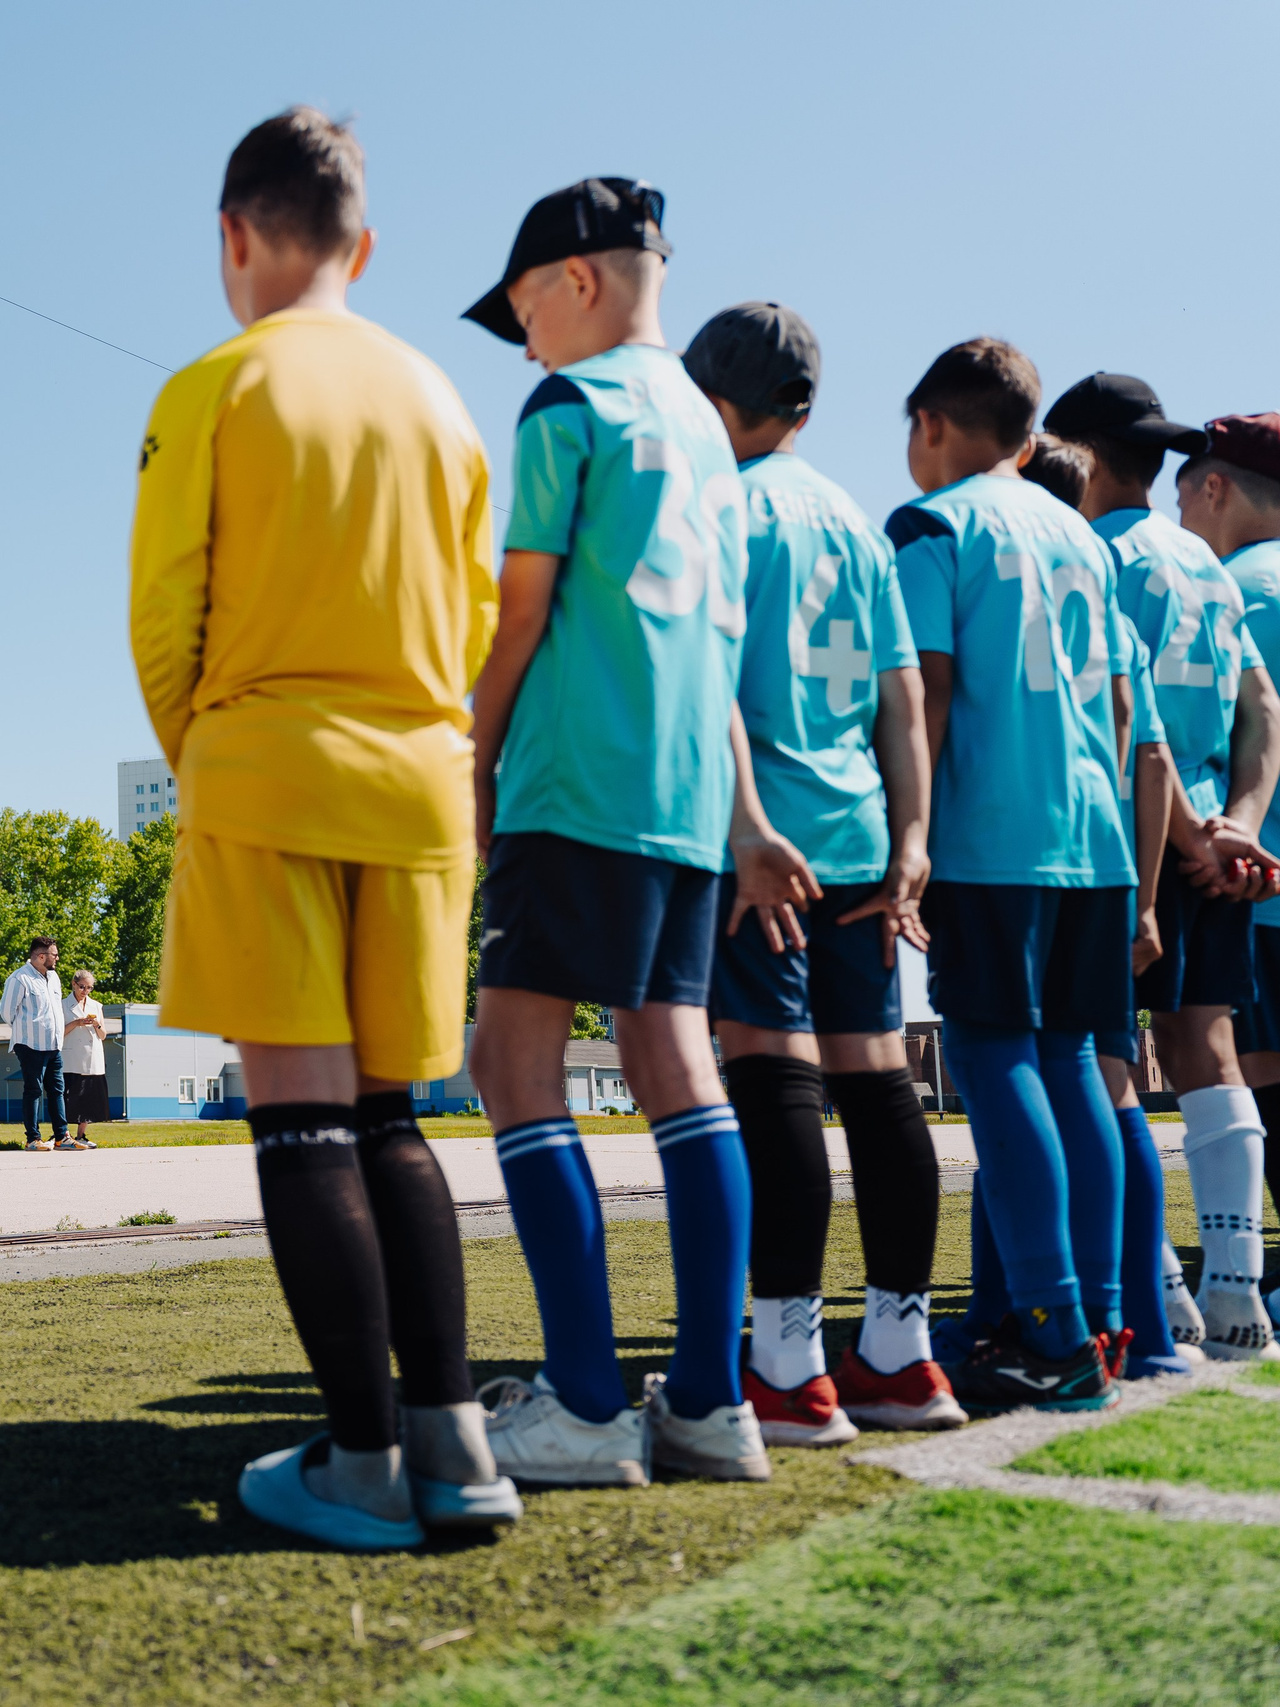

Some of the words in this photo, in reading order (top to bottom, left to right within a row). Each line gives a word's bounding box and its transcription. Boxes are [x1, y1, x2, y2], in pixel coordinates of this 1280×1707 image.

[625, 436, 750, 639] 30
[788, 553, 871, 713] 4
[995, 551, 1107, 705] 10
